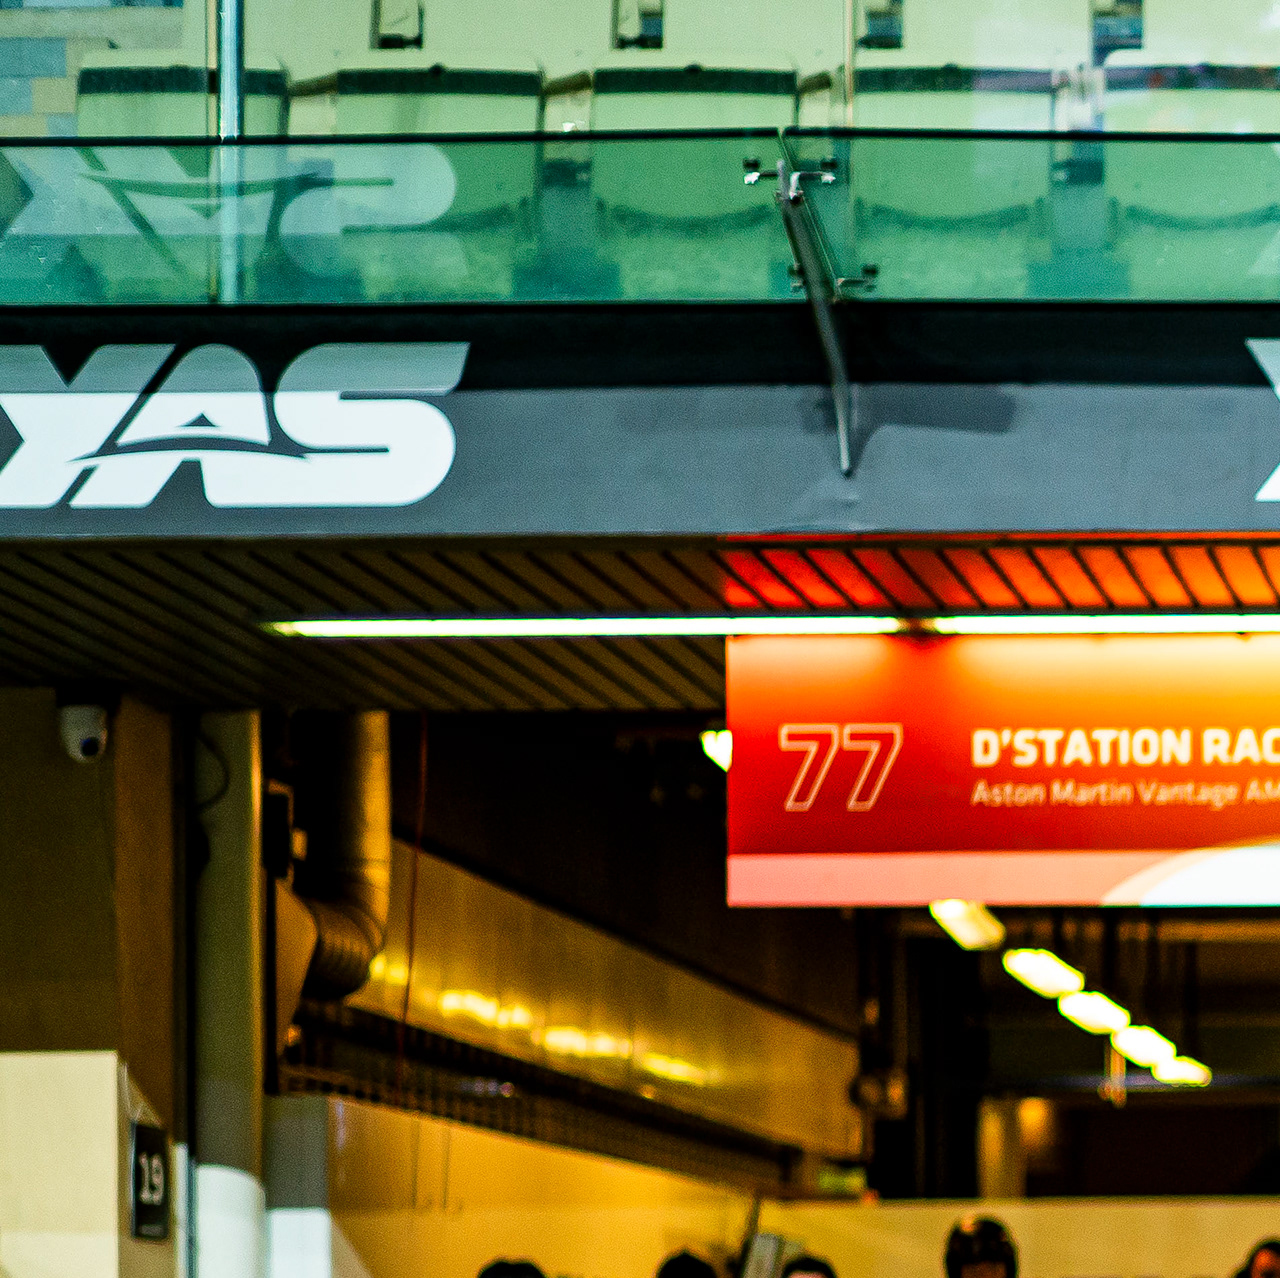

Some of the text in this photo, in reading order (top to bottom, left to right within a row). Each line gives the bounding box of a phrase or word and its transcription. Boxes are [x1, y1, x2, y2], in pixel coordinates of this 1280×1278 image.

[778, 723, 904, 812] 77
[971, 728, 1192, 768] D'STATION
[972, 780, 1045, 806] Aston
[1052, 780, 1131, 806] Martin
[1136, 779, 1237, 812] Vantage
[138, 1151, 164, 1206] 19
